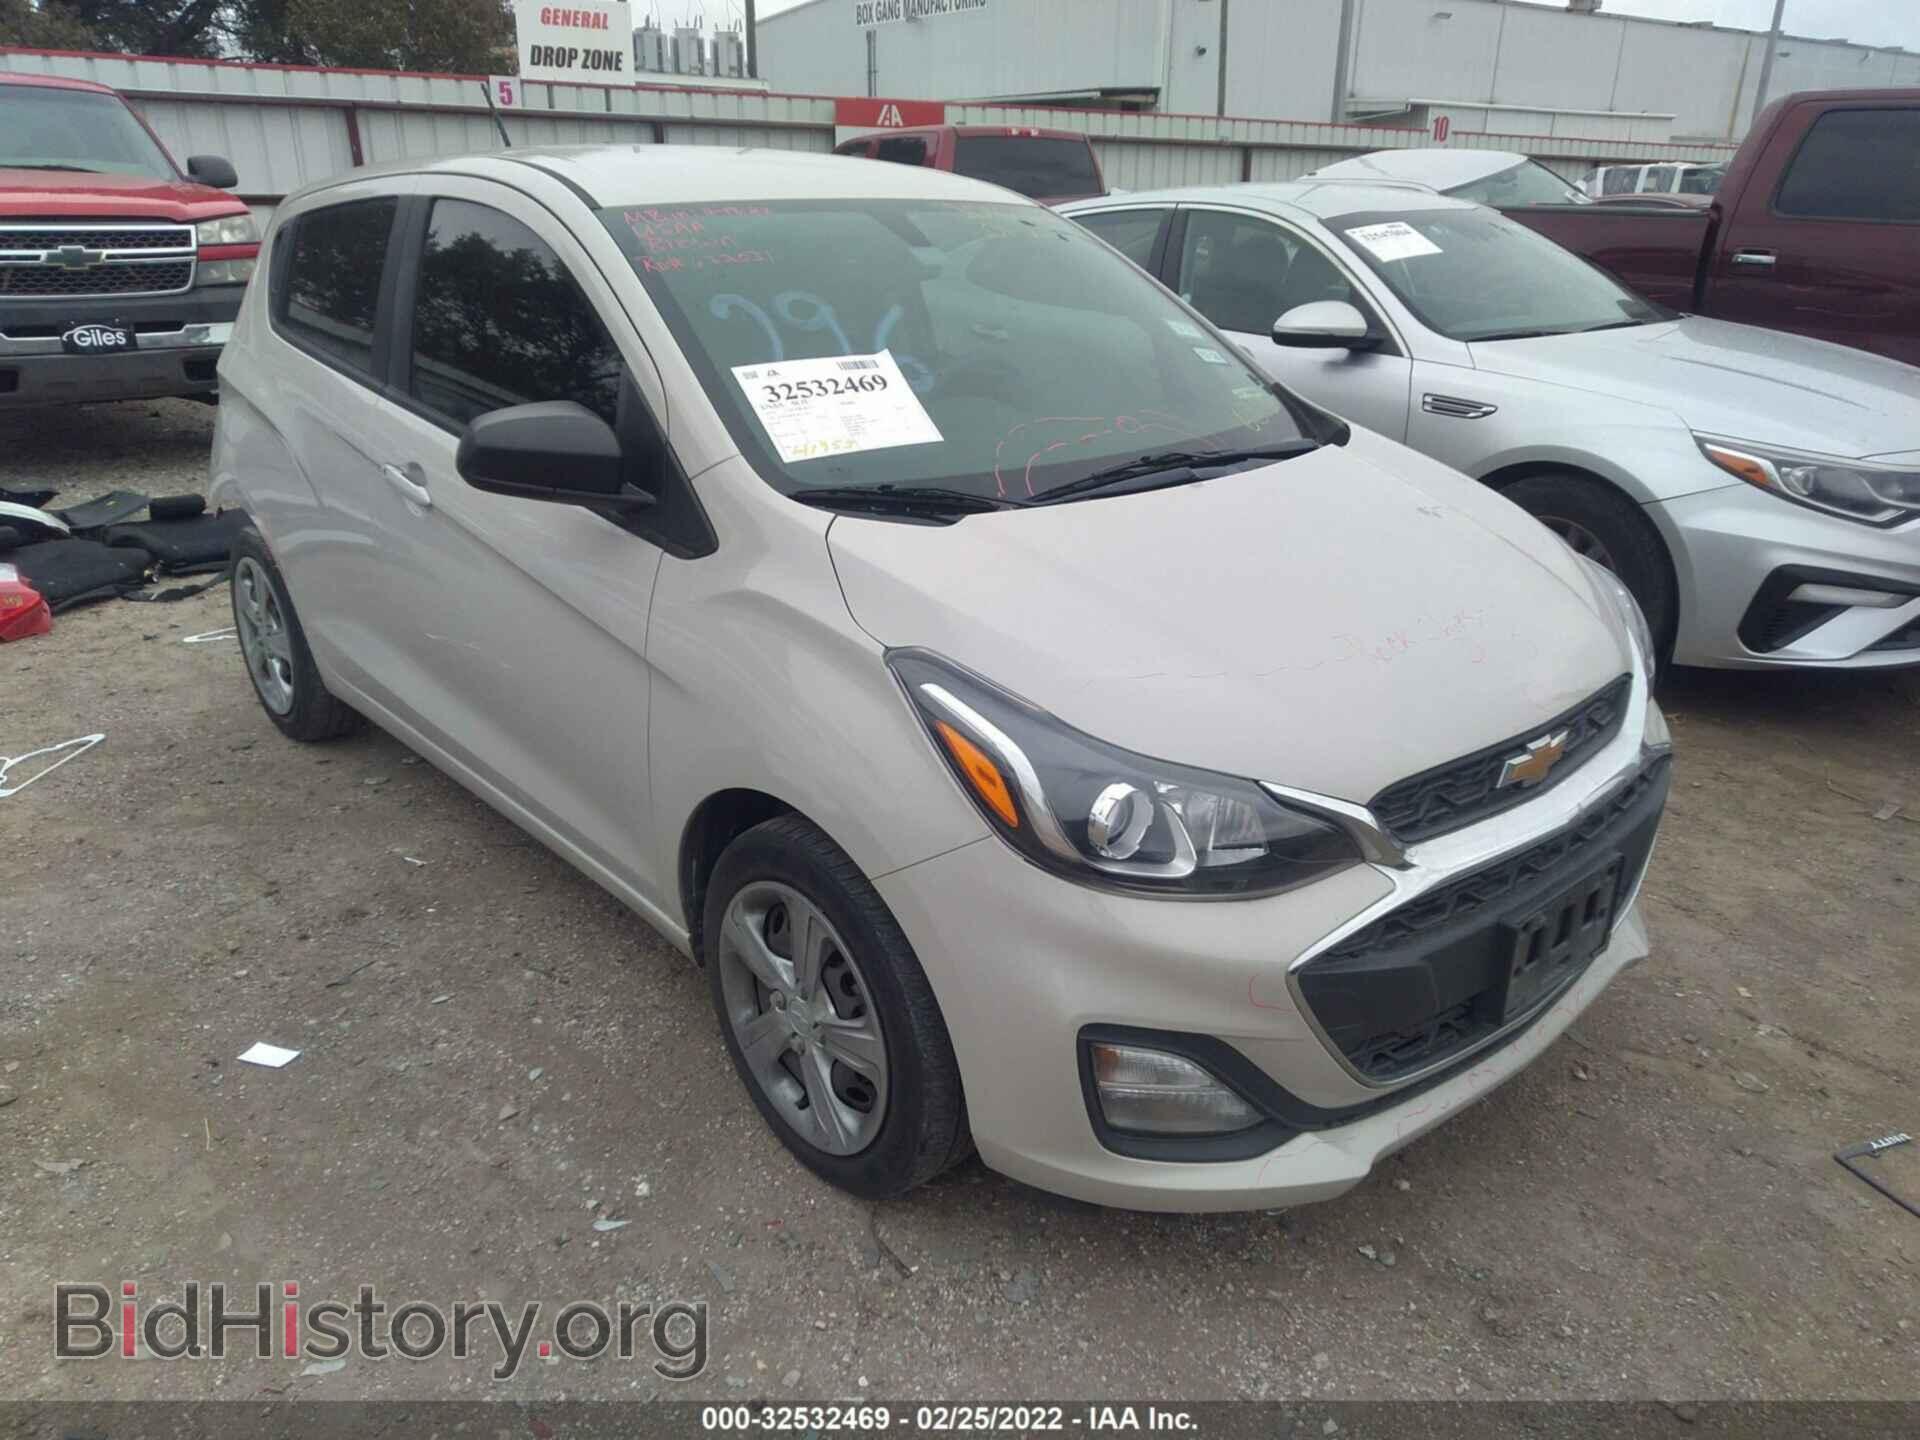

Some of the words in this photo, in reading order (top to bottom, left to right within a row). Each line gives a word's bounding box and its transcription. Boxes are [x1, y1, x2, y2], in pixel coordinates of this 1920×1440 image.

[540, 7, 609, 30] GENERAL
[856, 3, 875, 25] BOX
[874, 0, 901, 21] GANG
[530, 44, 578, 68] DROP
[581, 48, 624, 71] ZONE
[500, 81, 512, 105] 5
[1433, 115, 1449, 142] 10
[73, 329, 127, 346] Giles
[762, 373, 888, 403] 32532469
